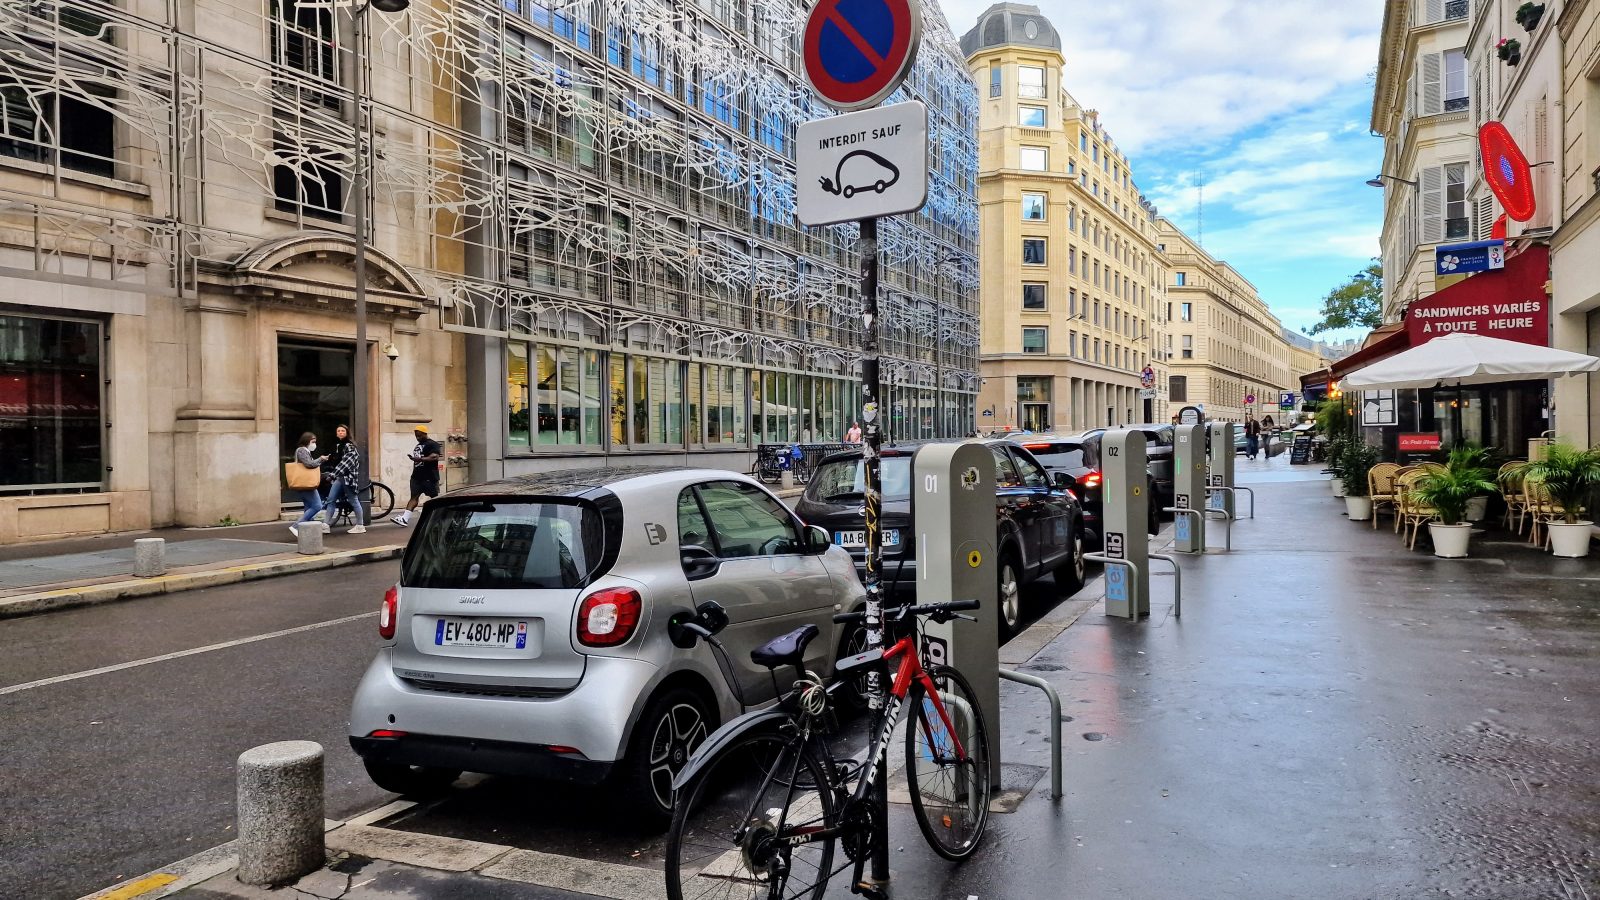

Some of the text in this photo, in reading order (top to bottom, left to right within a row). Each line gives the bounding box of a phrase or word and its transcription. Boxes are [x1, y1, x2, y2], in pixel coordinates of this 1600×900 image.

[819, 124, 901, 149] INTERDIT SAUF
[1414, 300, 1541, 318] SANDWICHS VARIÉS
[1423, 317, 1533, 333] À TOUTE HEURE
[1108, 446, 1119, 457] 02
[924, 474, 938, 494] 01
[458, 594, 486, 605] smart
[445, 622, 515, 643] EV-480-MP
[517, 634, 526, 645] 75
